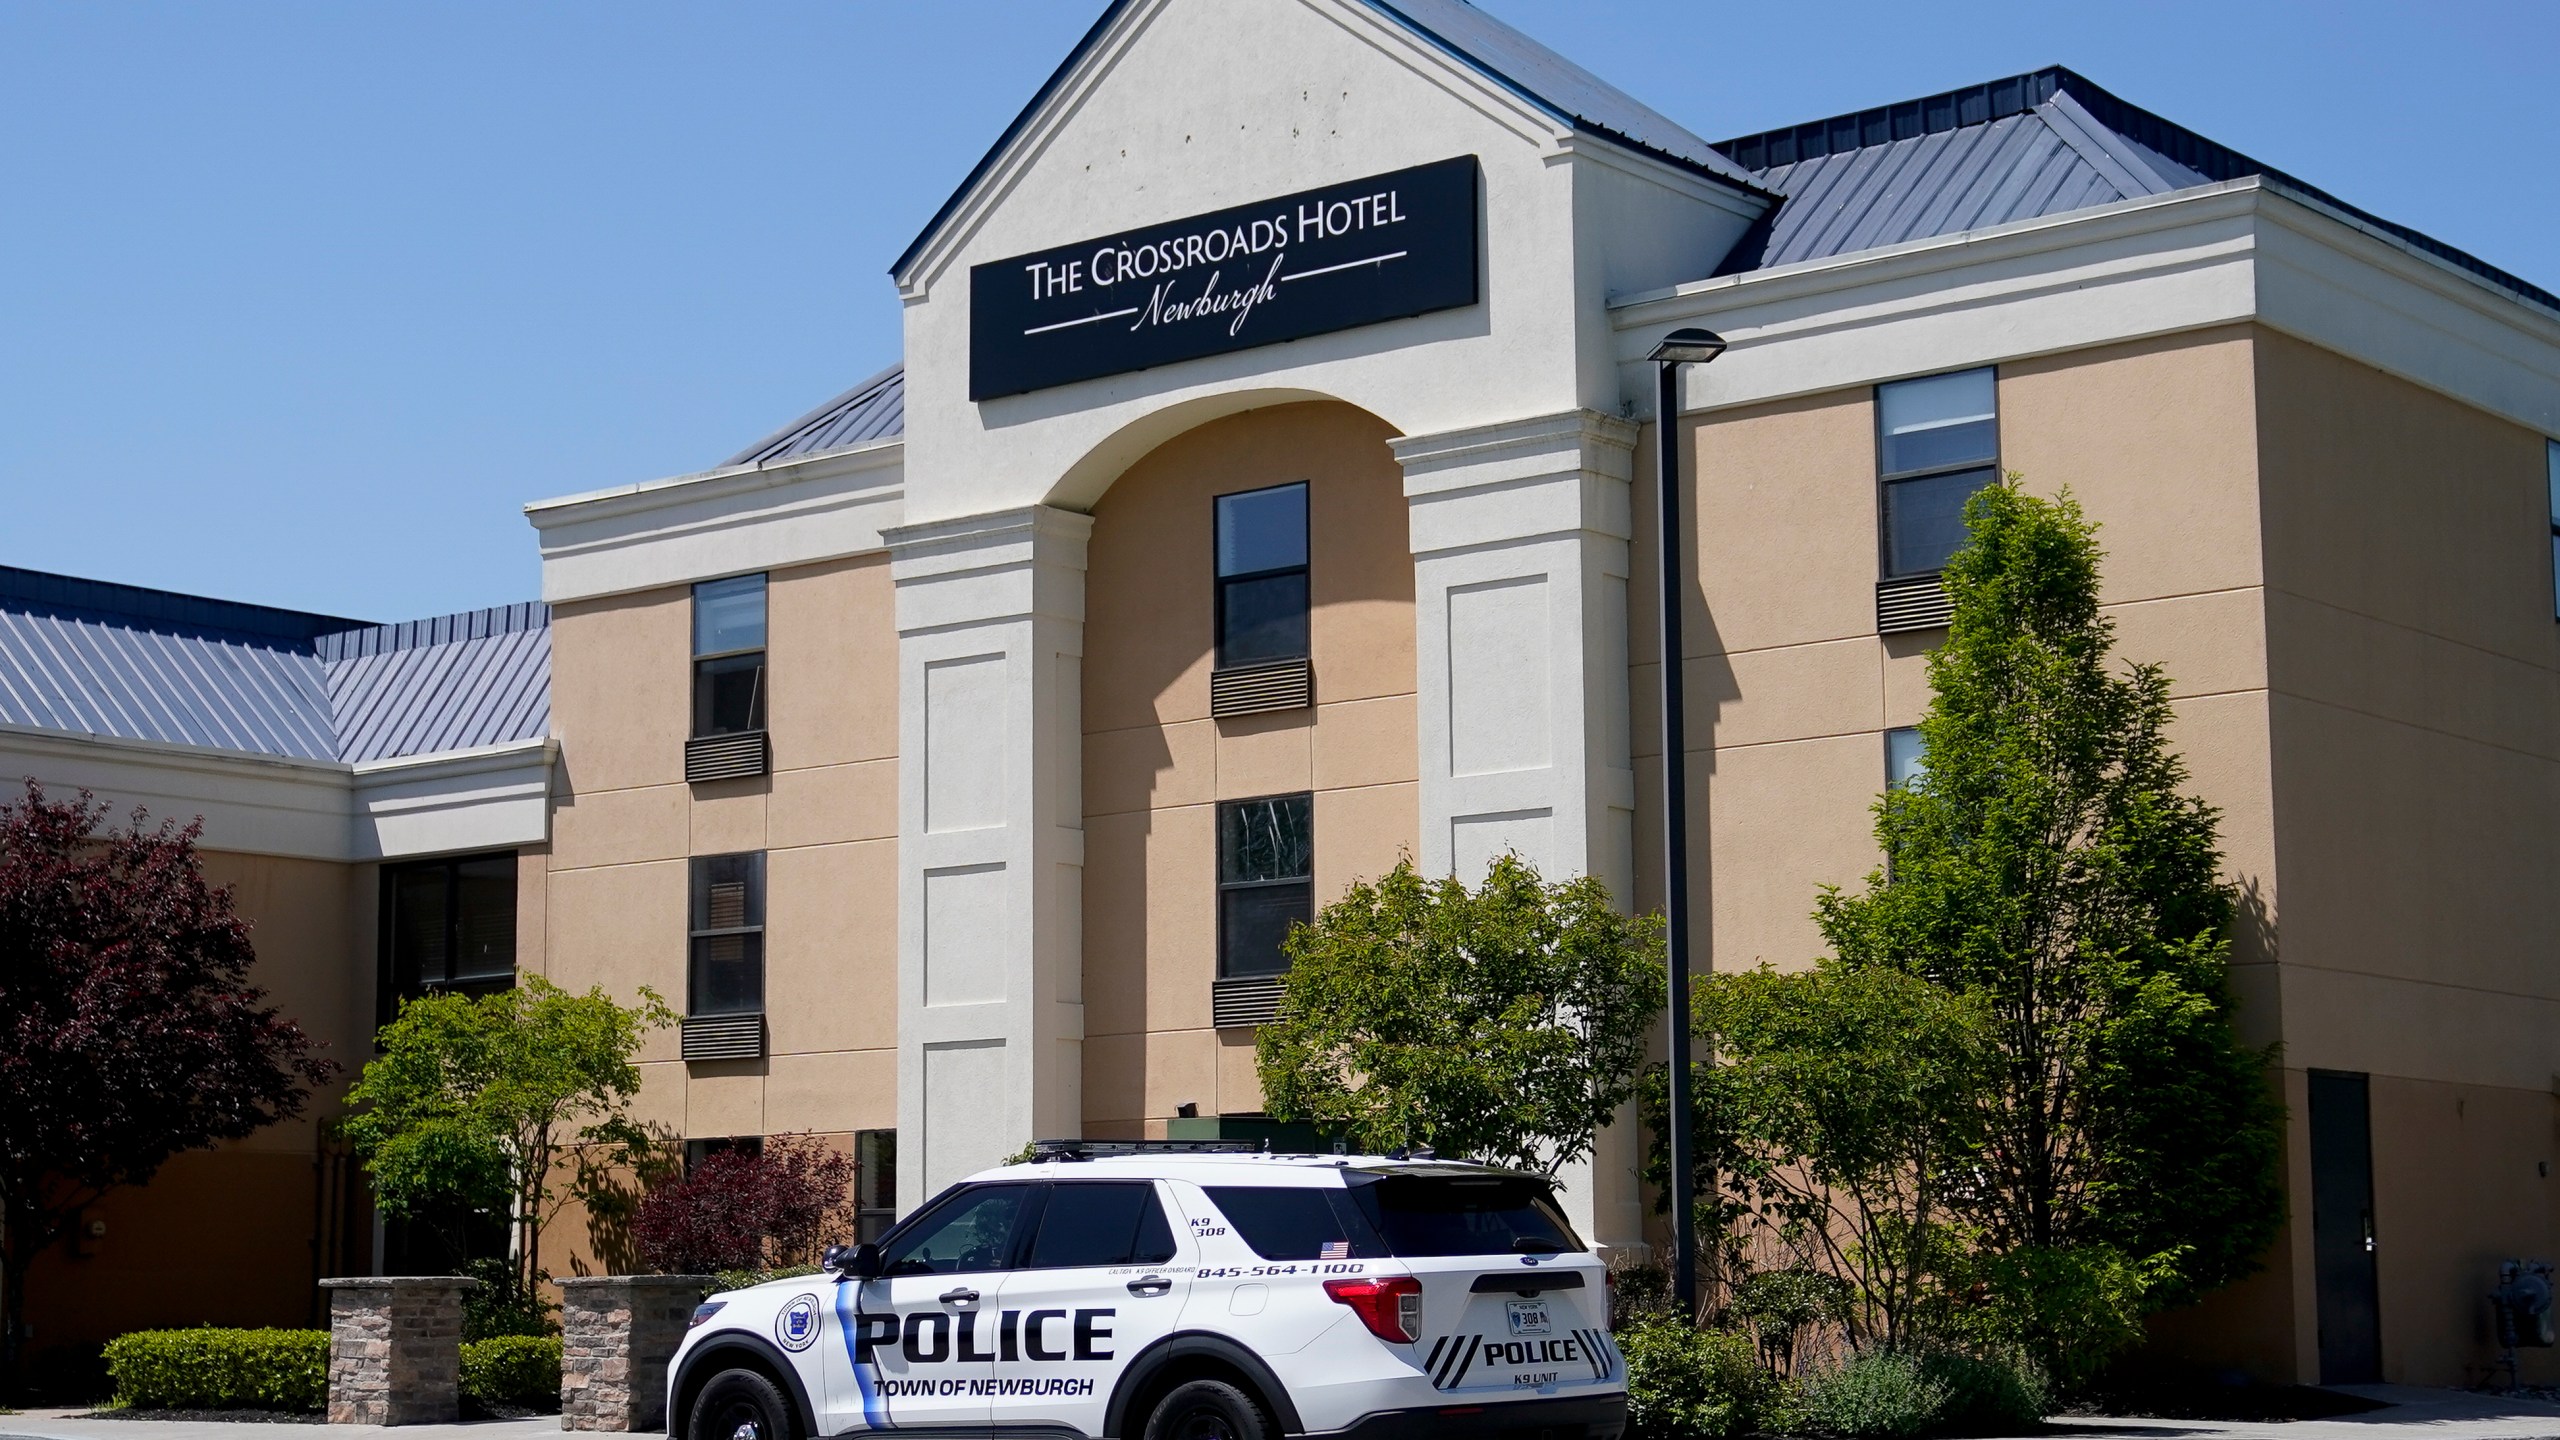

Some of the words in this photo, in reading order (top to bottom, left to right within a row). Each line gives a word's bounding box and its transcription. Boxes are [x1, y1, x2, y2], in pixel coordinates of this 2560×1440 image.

[1025, 261, 1083, 300] THE
[1091, 215, 1288, 287] CROSSROADS
[1298, 191, 1406, 243] HOTEL
[1130, 253, 1285, 337] Newburgh
[1190, 1217, 1211, 1227] K9
[1196, 1227, 1226, 1238] 308
[1196, 1263, 1364, 1279] 845-564-1100
[1521, 1312, 1539, 1325] 308
[854, 1307, 1117, 1364] POLICE
[1484, 1339, 1578, 1366] POLICE
[1514, 1373, 1530, 1384] K9
[1533, 1372, 1558, 1383] UNIT
[873, 1379, 936, 1397] TOWN
[939, 1379, 967, 1396] OF
[968, 1378, 1094, 1397] NEWBURGH
